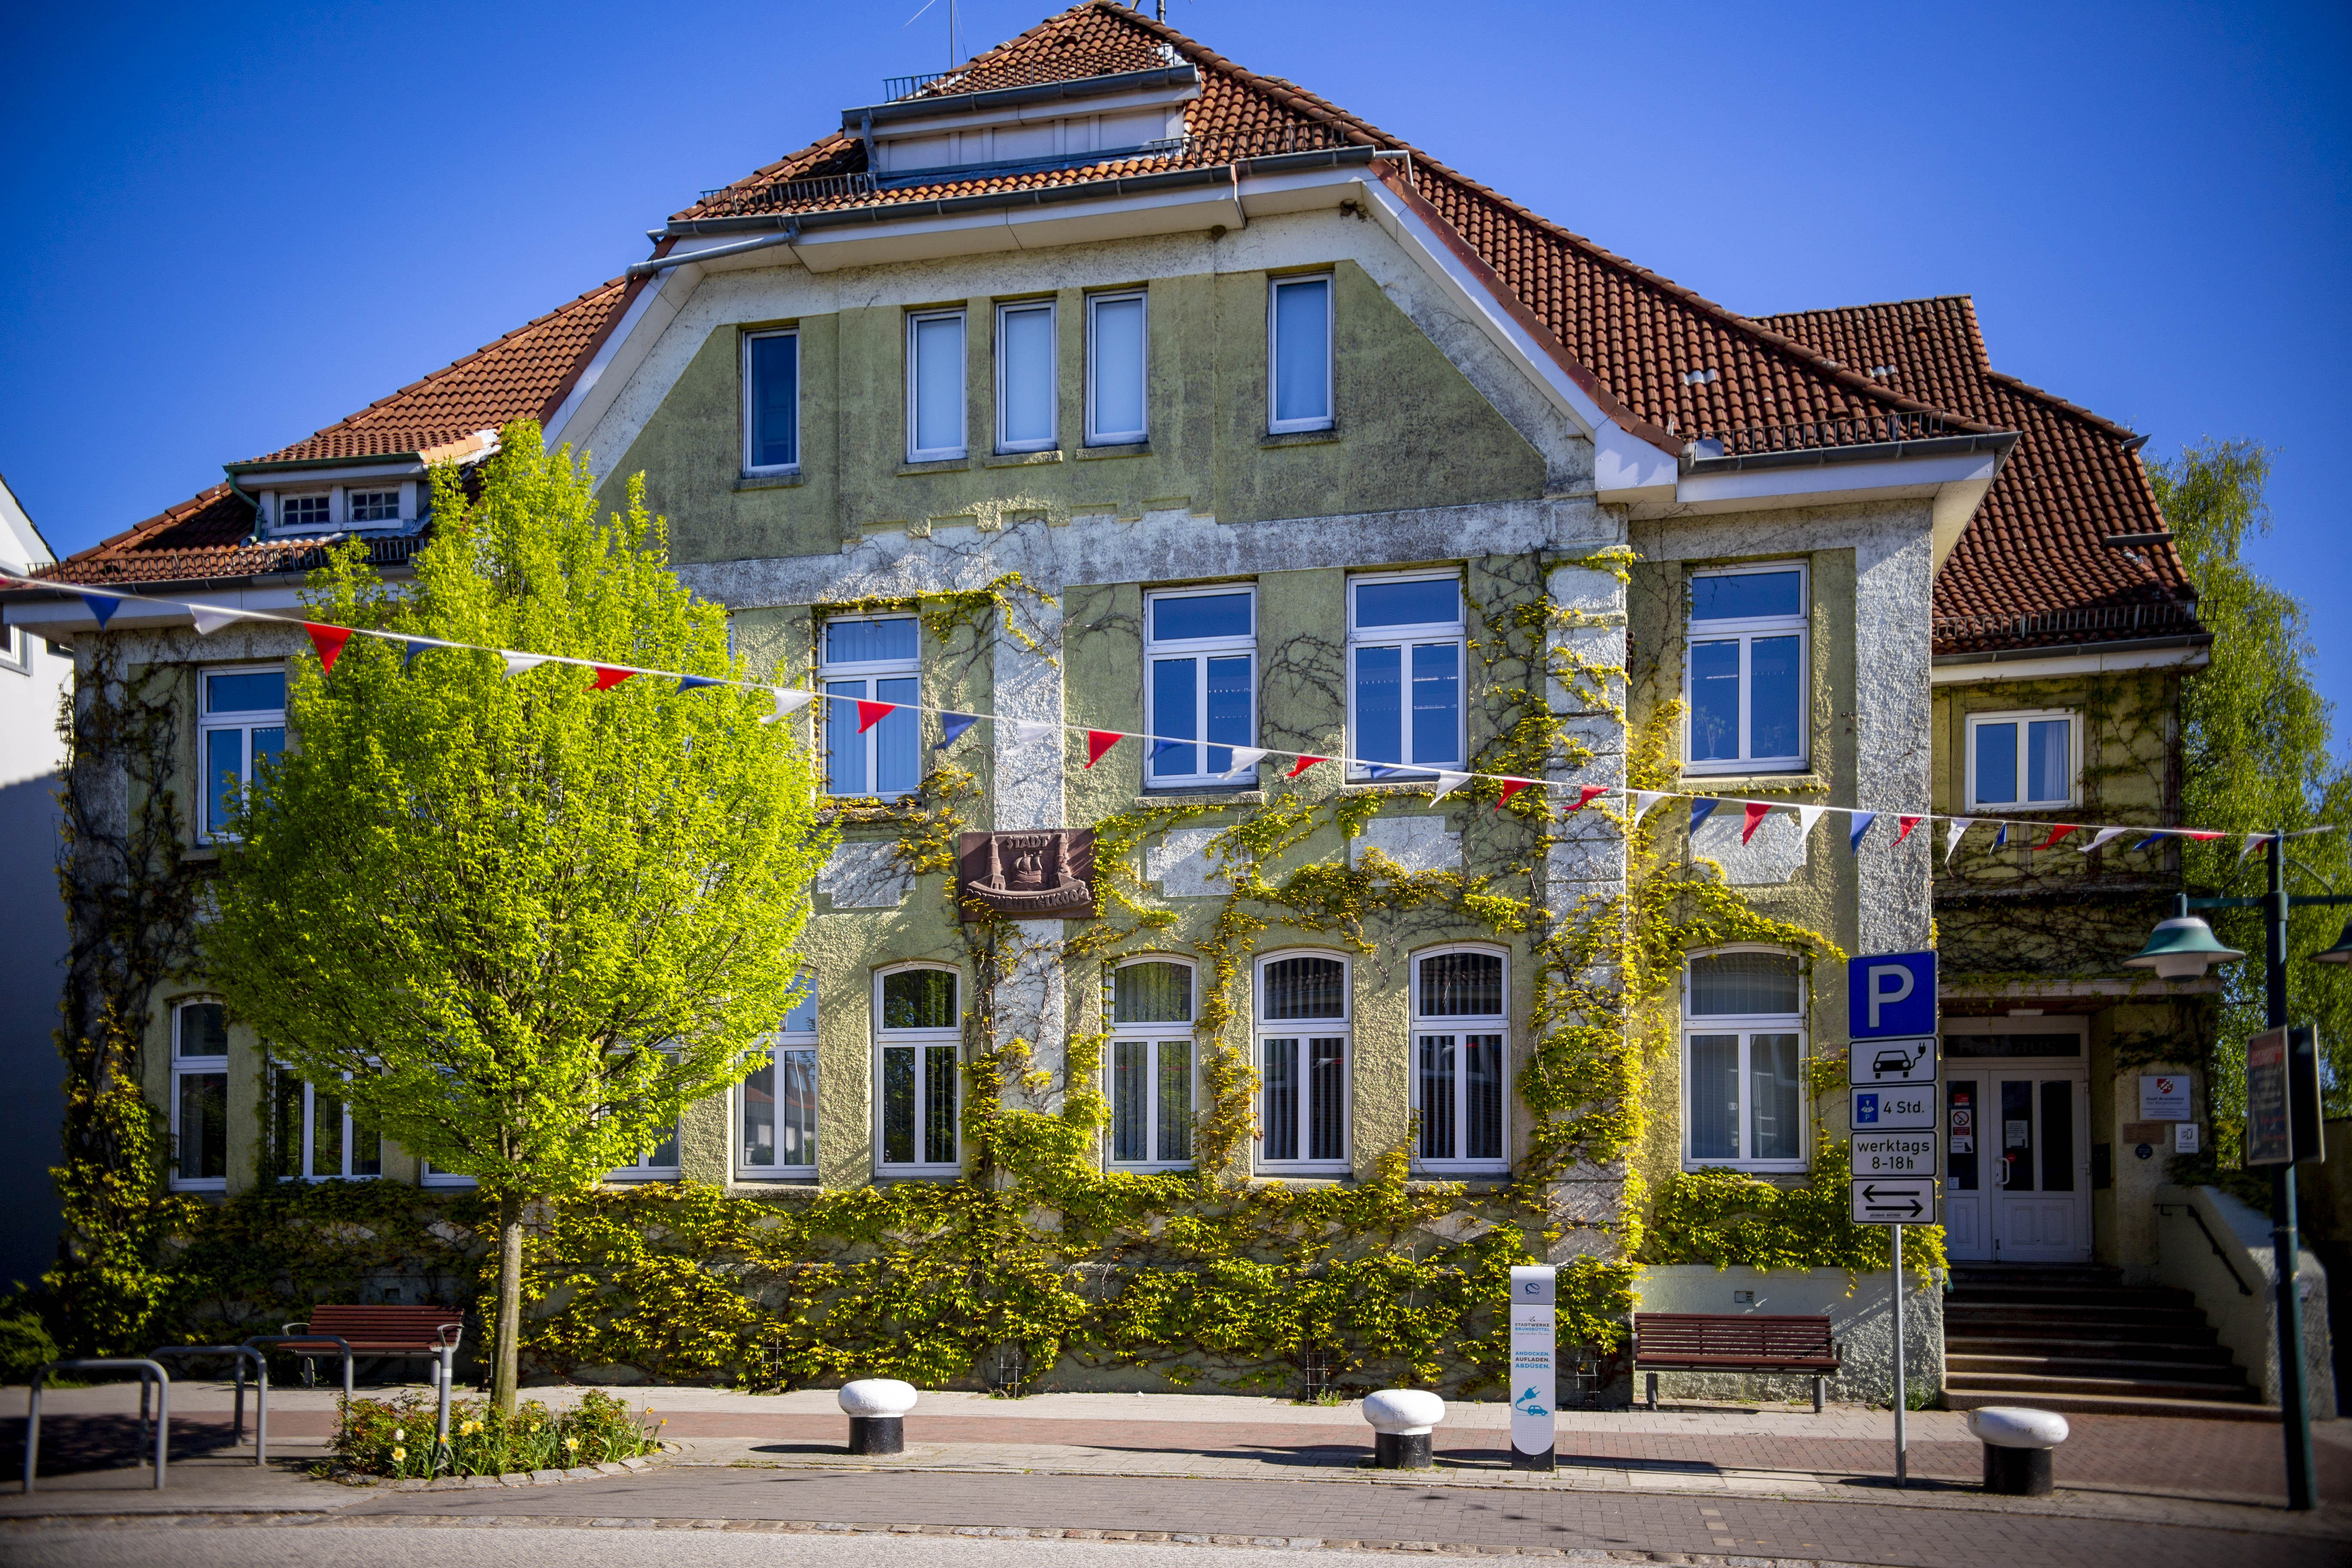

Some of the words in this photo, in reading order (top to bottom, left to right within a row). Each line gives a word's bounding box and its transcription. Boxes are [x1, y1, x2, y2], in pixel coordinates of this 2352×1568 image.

[1007, 835, 1050, 850] STADT
[1868, 964, 1914, 1028] P
[1883, 1102, 1891, 1114] 4
[1897, 1101, 1924, 1113] Std.
[1857, 1139, 1929, 1155] werktags
